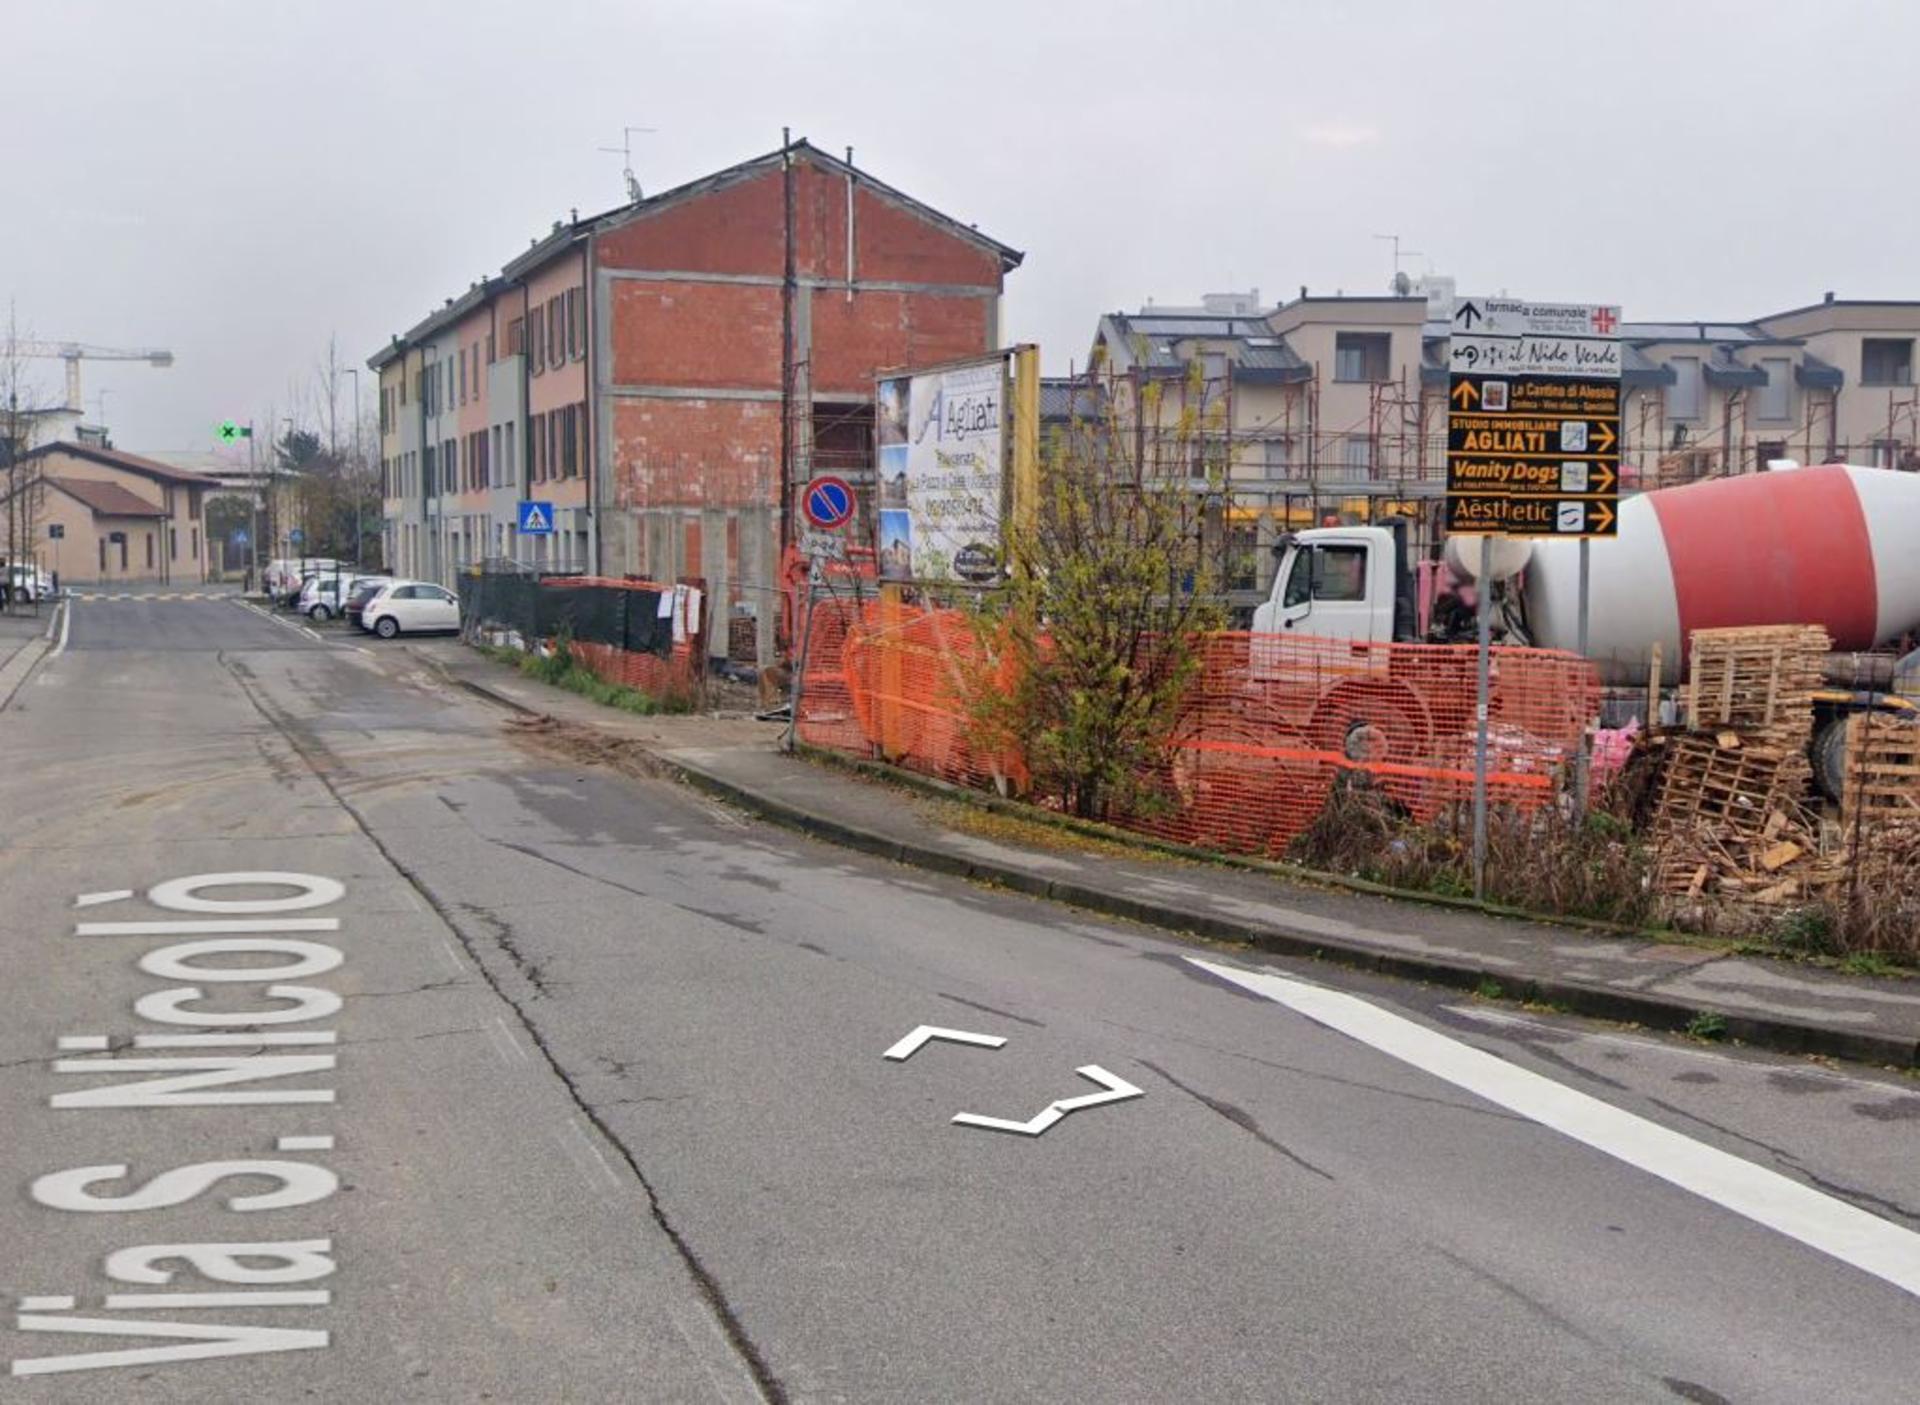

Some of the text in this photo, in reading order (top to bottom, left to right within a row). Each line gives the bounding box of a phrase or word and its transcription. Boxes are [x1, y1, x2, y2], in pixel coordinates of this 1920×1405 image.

[1485, 300, 1587, 318] farmaca comunale
[1529, 342, 1568, 362] Nido
[1576, 343, 1619, 365] Verde
[1451, 419, 1560, 432] STUDIO IMMOBILIARE
[1464, 431, 1545, 451] AGLIATI
[1454, 460, 1560, 484] Vanity Dogs
